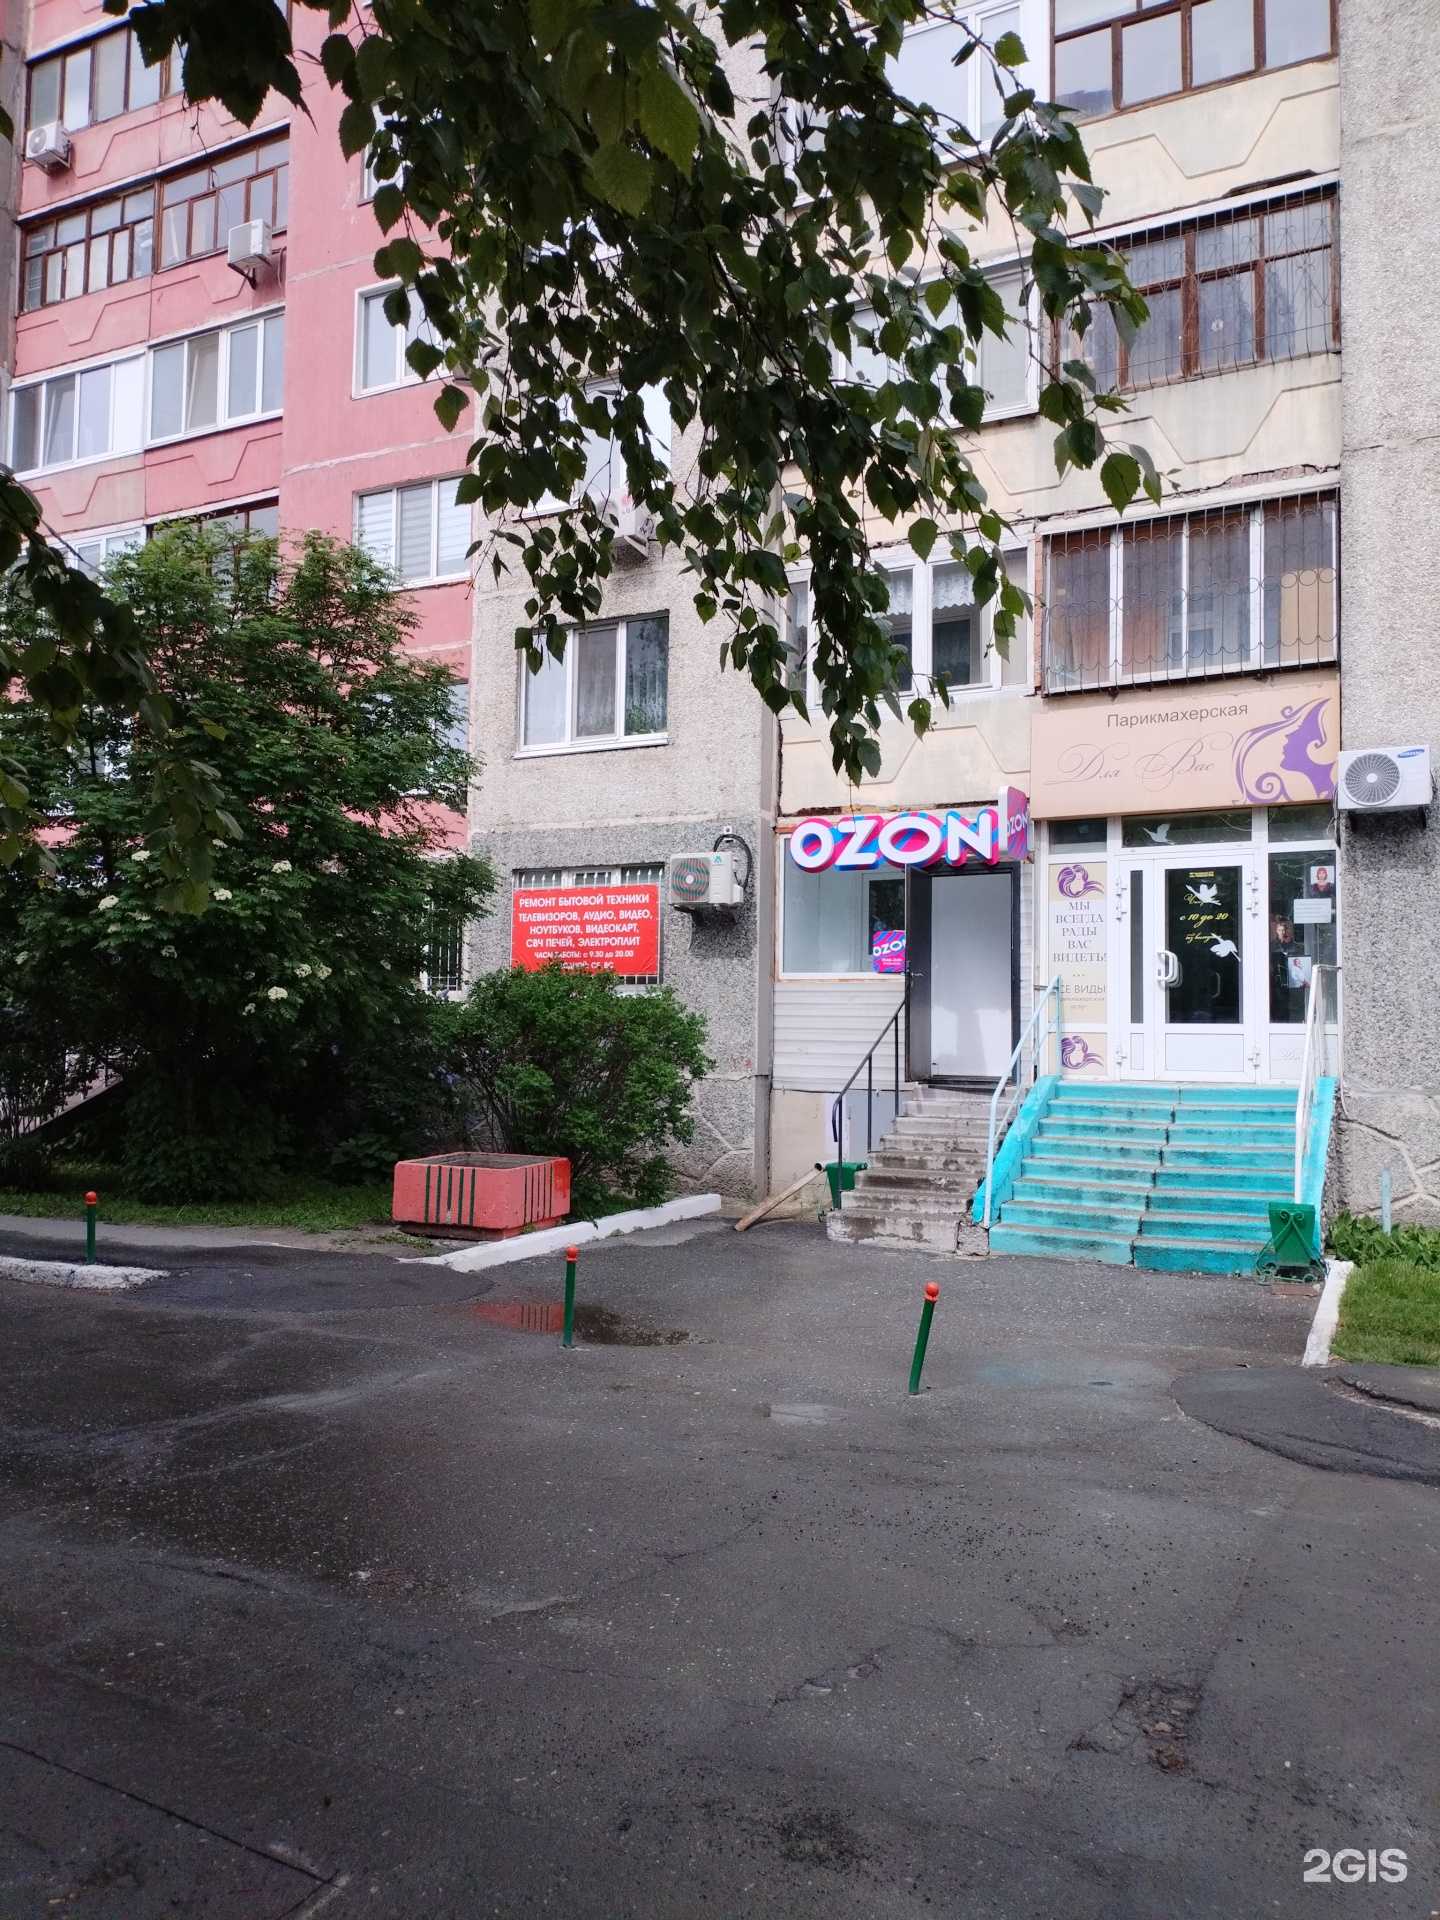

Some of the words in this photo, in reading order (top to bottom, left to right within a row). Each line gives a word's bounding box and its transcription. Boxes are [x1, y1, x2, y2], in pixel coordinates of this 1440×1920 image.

[1107, 704, 1248, 729] Парикмахерская
[1043, 743, 1130, 786] Для
[789, 809, 997, 871] OZON
[519, 897, 557, 908] РЕМОНТ
[559, 895, 603, 906] БЫТОВОЙ
[606, 893, 649, 905] ТЕХНИКИ
[1069, 901, 1090, 910] МЫ
[519, 911, 580, 922] ТЕЛЕВИЗОРОВ,
[583, 910, 616, 921] АУДИО,
[619, 909, 653, 920] ВИДЕО,
[1056, 913, 1104, 924] ВСЕГДА
[1188, 913, 1200, 921] 10
[1215, 912, 1229, 920] 20
[529, 924, 583, 935] НОУТБУКОВ,
[585, 923, 639, 934] ВИДЕОКАРТ,
[1062, 927, 1097, 937] РАДЫ
[526, 938, 543, 948] СВЧ
[546, 936, 575, 948] ПЕЧЕЙ,
[578, 936, 640, 947] ЭЛЕКТРОПЛИТ
[1067, 939, 1092, 950] ВАС
[1074, 984, 1106, 993] ВИДЫ
